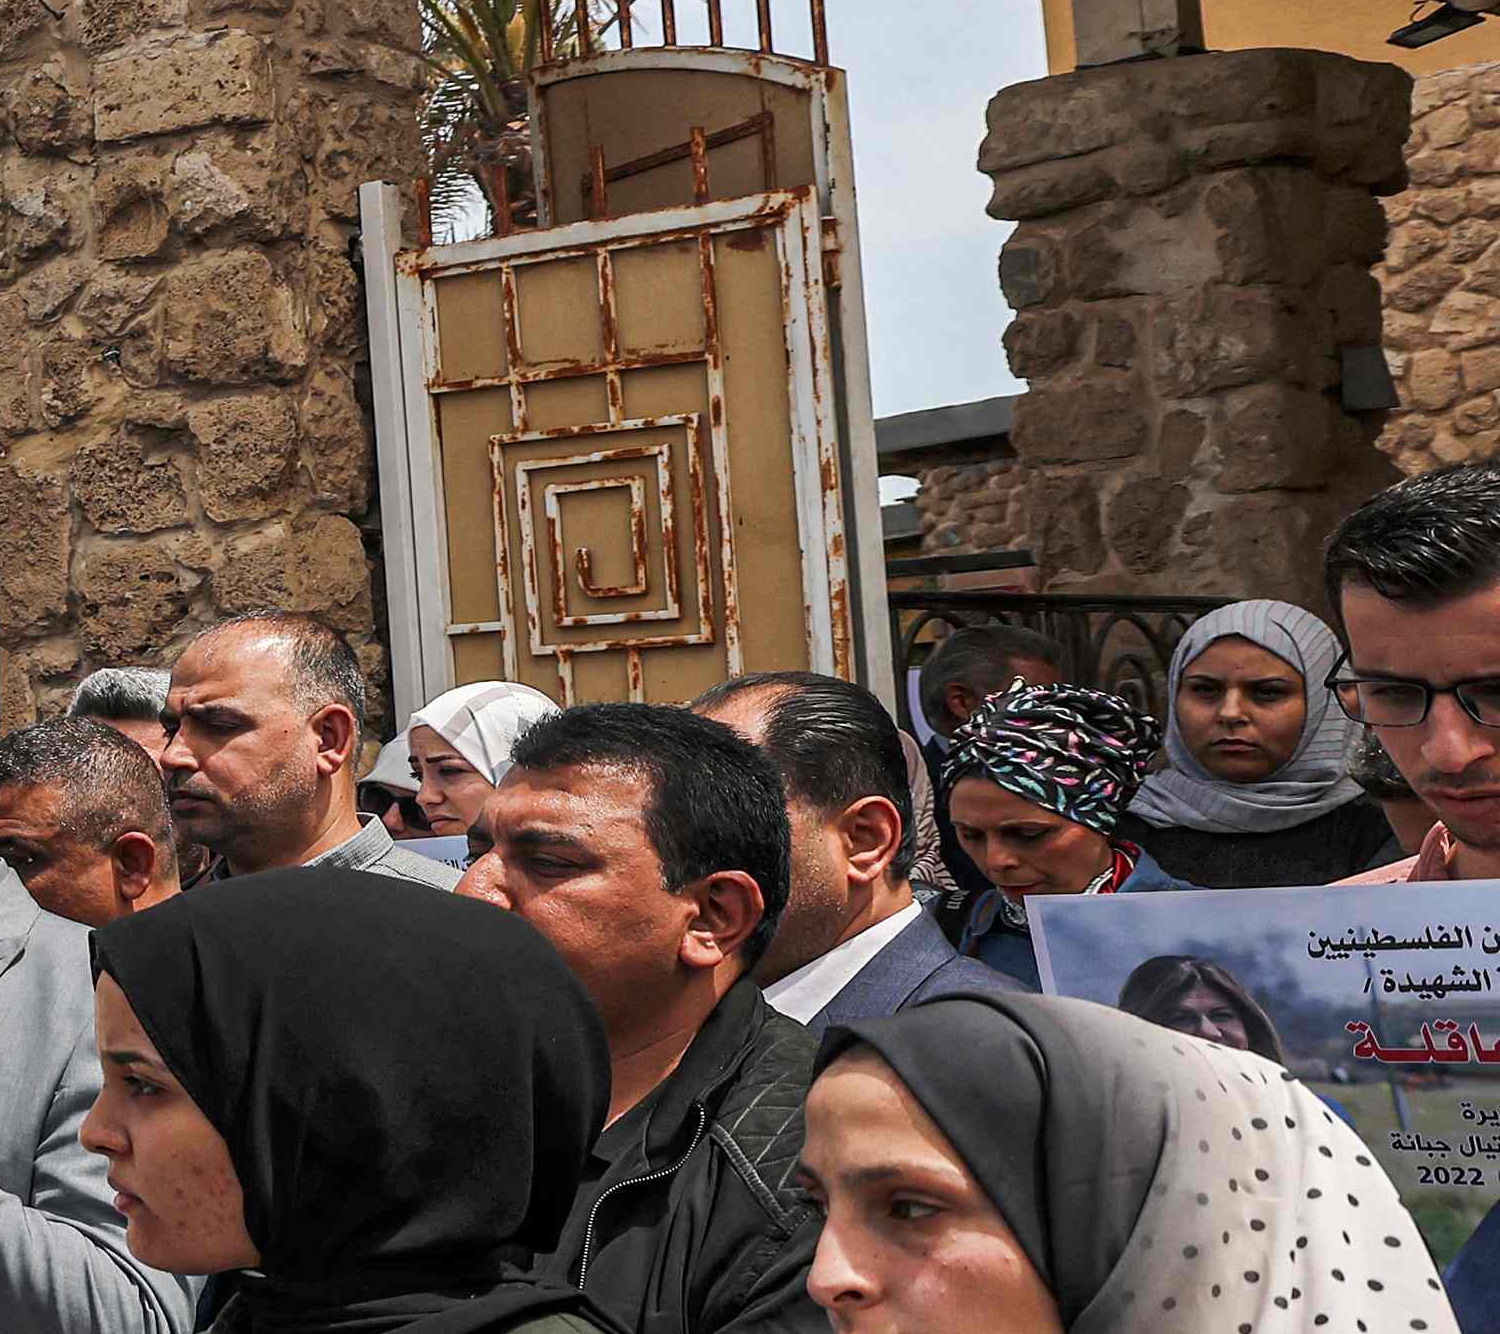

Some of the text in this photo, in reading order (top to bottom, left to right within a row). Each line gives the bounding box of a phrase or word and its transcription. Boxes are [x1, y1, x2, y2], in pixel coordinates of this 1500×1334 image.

[1307, 925, 1474, 960] الفلسطينيين
[1380, 965, 1491, 1000] الشهيدة
[1389, 1131, 1451, 1159] جبانة
[1416, 1165, 1486, 1187] 2022
